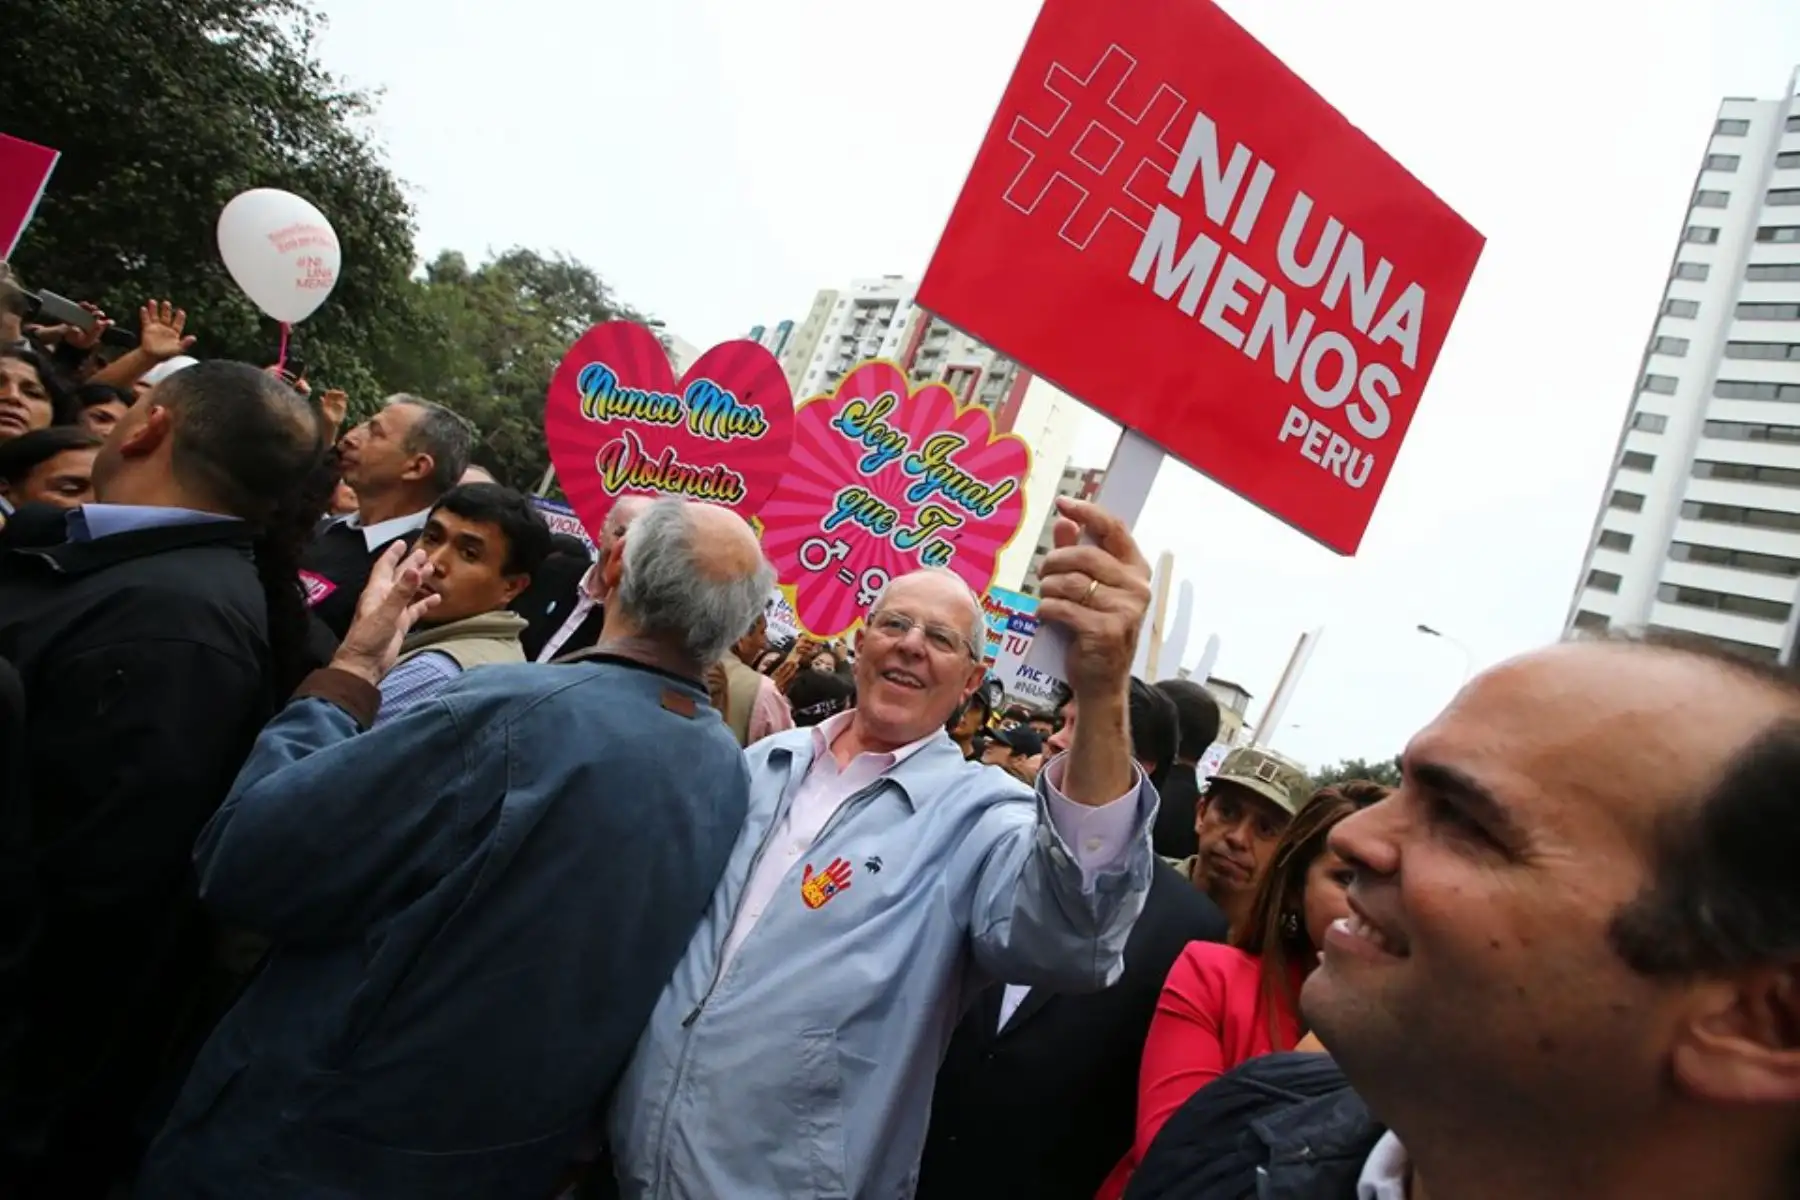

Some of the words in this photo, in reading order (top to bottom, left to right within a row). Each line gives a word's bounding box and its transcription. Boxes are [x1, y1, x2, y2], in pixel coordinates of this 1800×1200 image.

[1276, 190, 1426, 370] UNA
[1128, 203, 1401, 439] MENOS
[578, 361, 686, 427] Nunca
[597, 429, 747, 504] Violencia
[831, 391, 910, 473] Soy
[902, 432, 1017, 517] Igual
[1277, 405, 1375, 489] PERÚ
[821, 485, 898, 535] que
[1005, 634, 1029, 656] TU
